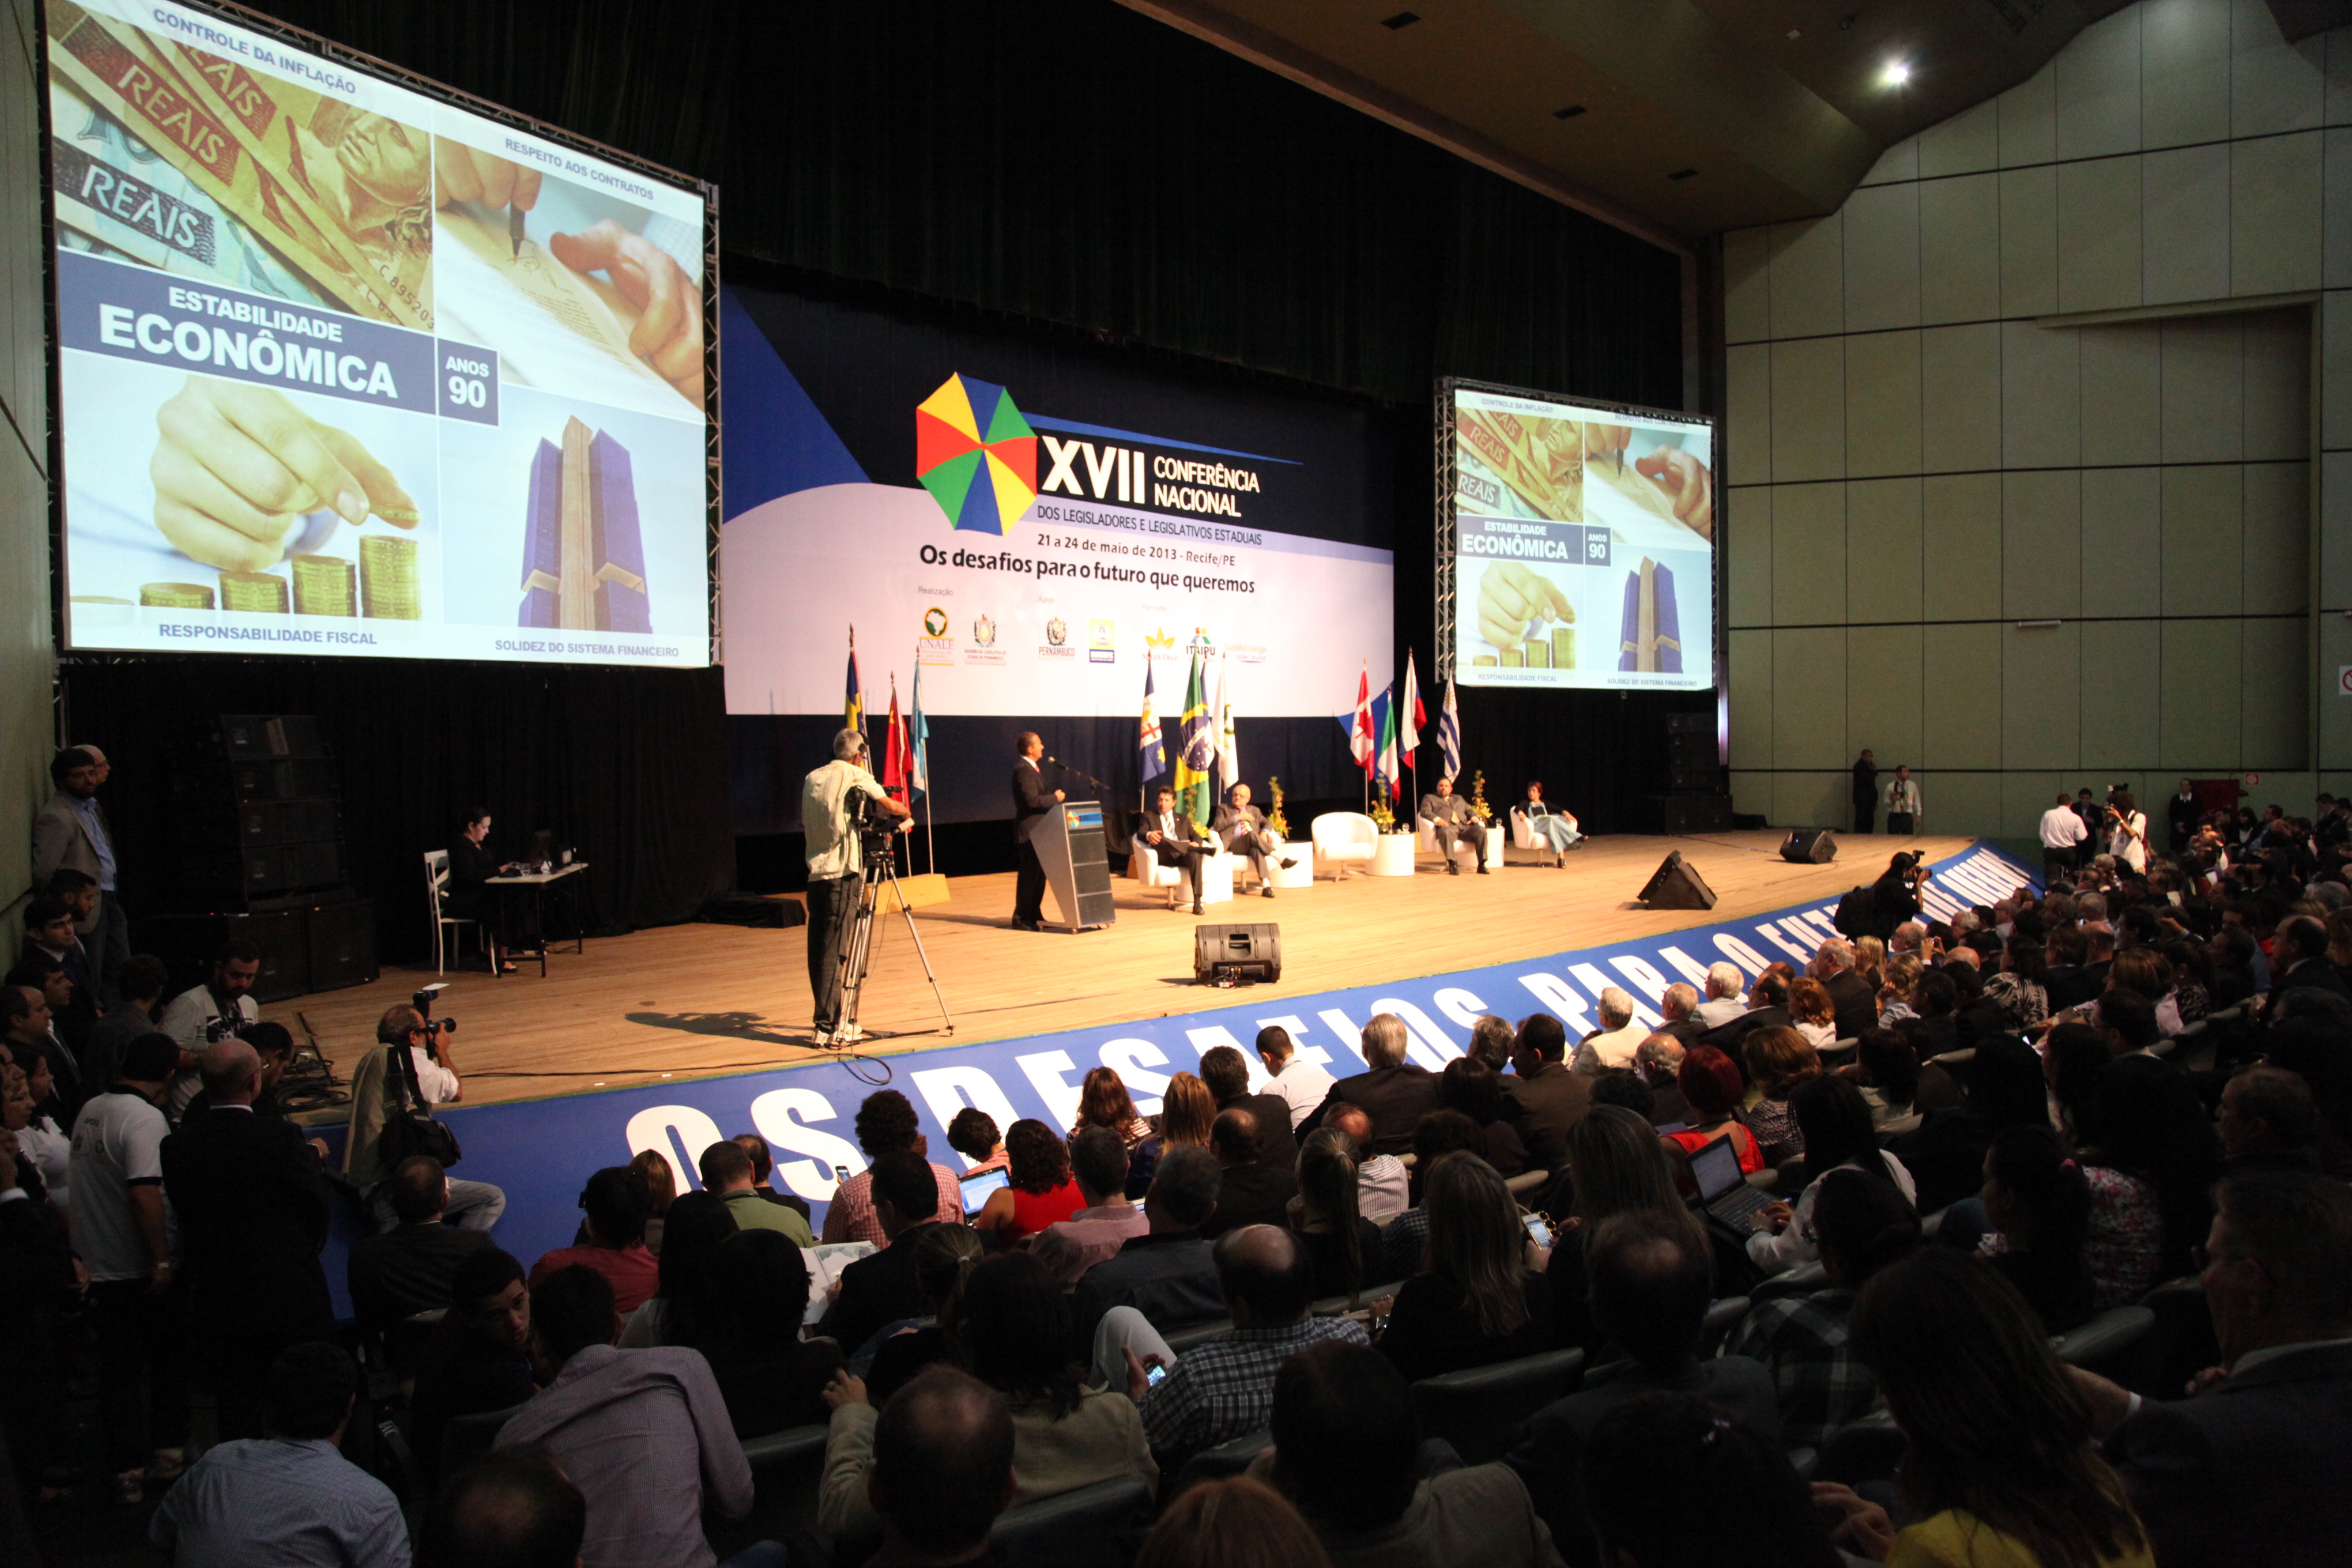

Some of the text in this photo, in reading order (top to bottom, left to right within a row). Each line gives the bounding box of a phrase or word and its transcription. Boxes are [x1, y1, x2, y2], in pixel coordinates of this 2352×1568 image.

[153, 9, 356, 94] CONTROLE DA INFLAÇÃO
[183, 44, 262, 116] AIS
[117, 65, 225, 165] REAIS
[506, 138, 654, 201] RESPEITO AOS CONTRATOS
[81, 164, 199, 248] REAIS
[168, 287, 343, 343] ESTABILIDADE
[100, 303, 398, 398] ECONÔMICA
[446, 356, 489, 378] ANOS
[448, 376, 486, 408] 90
[1482, 398, 1514, 408] CONTROLE
[1524, 403, 1553, 413] INFLAÇÃO
[1615, 413, 1641, 423] RESPEITO
[1470, 425, 1505, 462] REAIS
[1042, 435, 1145, 504] XVII
[1154, 455, 1260, 493] CONFERÊNCIA
[1154, 483, 1242, 517] NACIONAL
[1458, 474, 1496, 503] REAIS
[1038, 505, 1262, 545] DOS LEGISLADORES E LEGISLATIVOS ESTADUAIS
[1484, 521, 1547, 536] ESTABILIDADE
[1588, 533, 1607, 542] ANOS
[1038, 533, 1051, 546] 21
[1054, 538, 1061, 548] a
[1064, 536, 1079, 550] 24
[1081, 538, 1096, 552] de
[1099, 541, 1129, 555] maio
[1132, 542, 1146, 557] de
[1149, 546, 1177, 560] 2013
[1186, 551, 1235, 568] Recife/PE
[1462, 534, 1569, 560] ECONÔMICA
[1589, 543, 1606, 559] 90
[920, 545, 1255, 593] Os desafios para o futuro que queremos
[918, 586, 953, 597] Realização
[160, 623, 378, 645] RESPONSABILIDADE FISCAL
[495, 639, 679, 657] SOLIDEZ DO SISTEMA FINANCEIRO
[919, 639, 954, 650] UNALE
[1038, 646, 1075, 657] PERNAMBUCO
[1478, 673, 1536, 681] RESPONSABILIDADE
[626, 1088, 868, 1201] OS
[910, 987, 1517, 1170] DESAFIOS
[1518, 946, 1748, 1038] PARA
[1713, 933, 1772, 978] O
